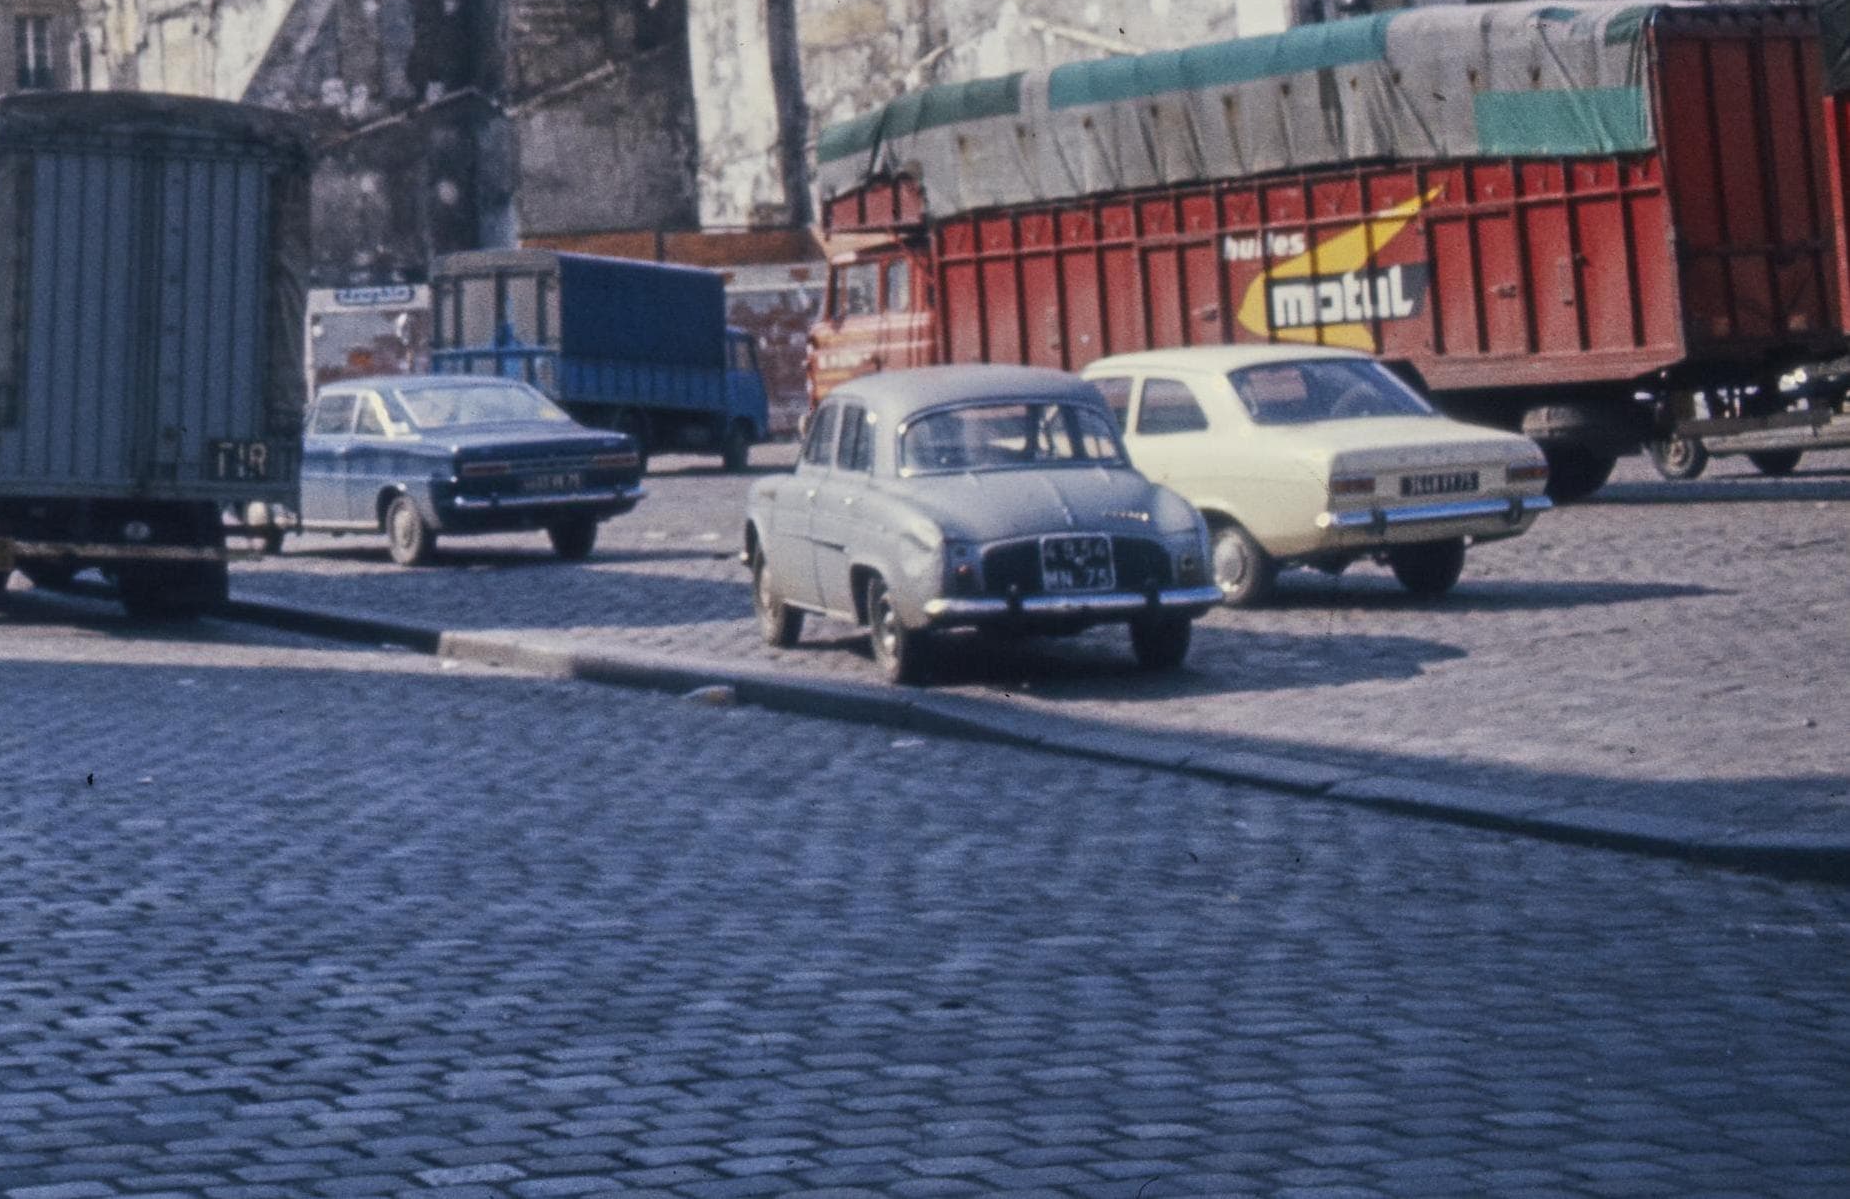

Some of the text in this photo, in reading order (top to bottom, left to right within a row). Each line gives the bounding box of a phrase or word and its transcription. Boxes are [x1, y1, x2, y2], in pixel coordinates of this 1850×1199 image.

[1224, 230, 1306, 261] huiles
[1272, 264, 1415, 327] motul
[215, 441, 268, 479] TIR
